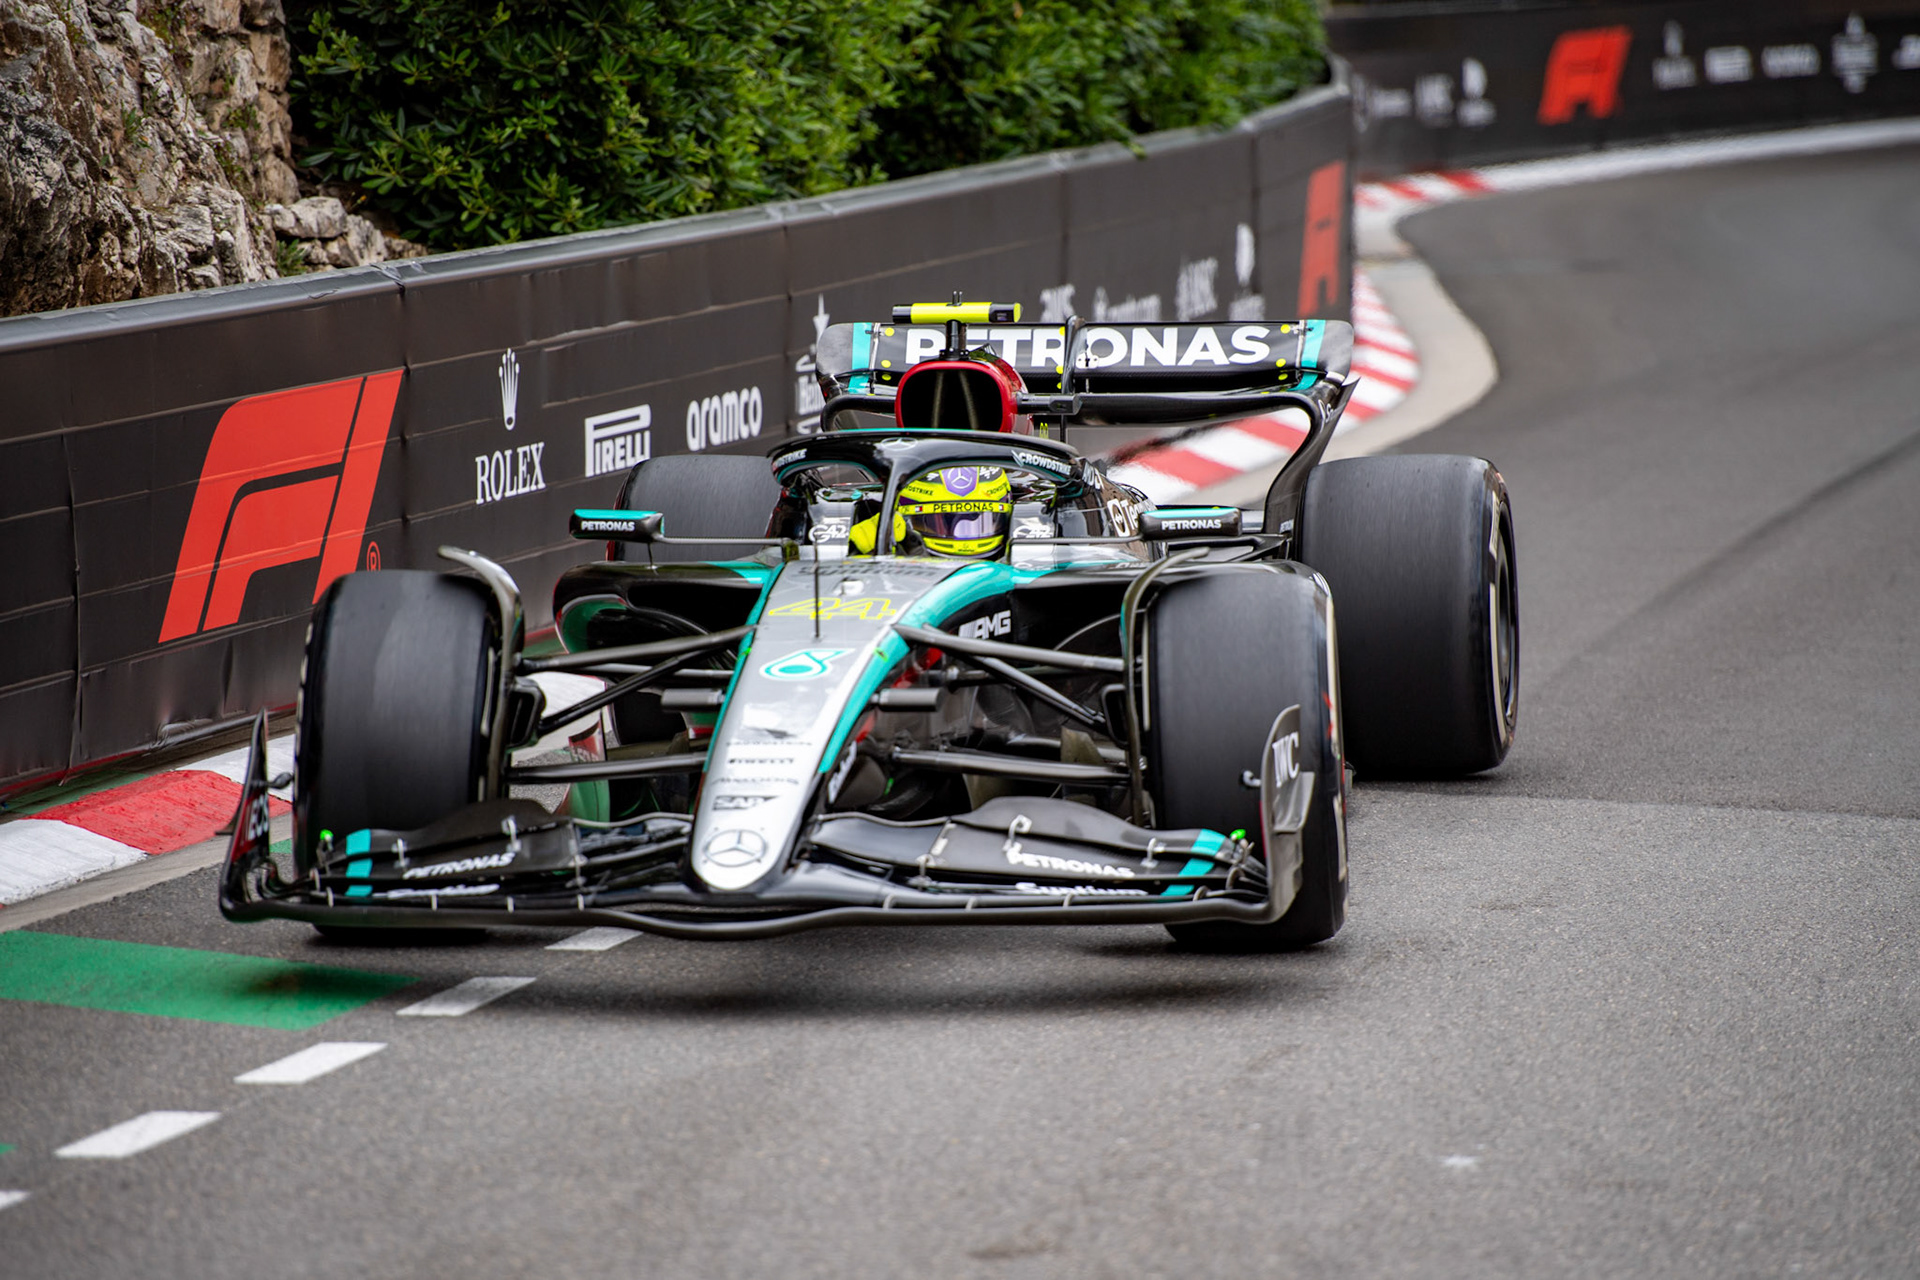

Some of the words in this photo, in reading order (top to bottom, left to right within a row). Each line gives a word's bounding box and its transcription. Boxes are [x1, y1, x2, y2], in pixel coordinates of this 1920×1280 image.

[686, 386, 763, 452] aramco
[584, 404, 651, 478] PIRELLI
[475, 441, 546, 505] ROLEX
[1018, 452, 1072, 476] CROWDSTRIKE
[933, 502, 994, 512] PETRONAS
[581, 521, 636, 532] PETRONAS
[1161, 519, 1222, 531] PETRONAS
[768, 597, 897, 620] 44
[402, 851, 516, 880] PETRONAS
[1006, 842, 1136, 878] PETRONAS
